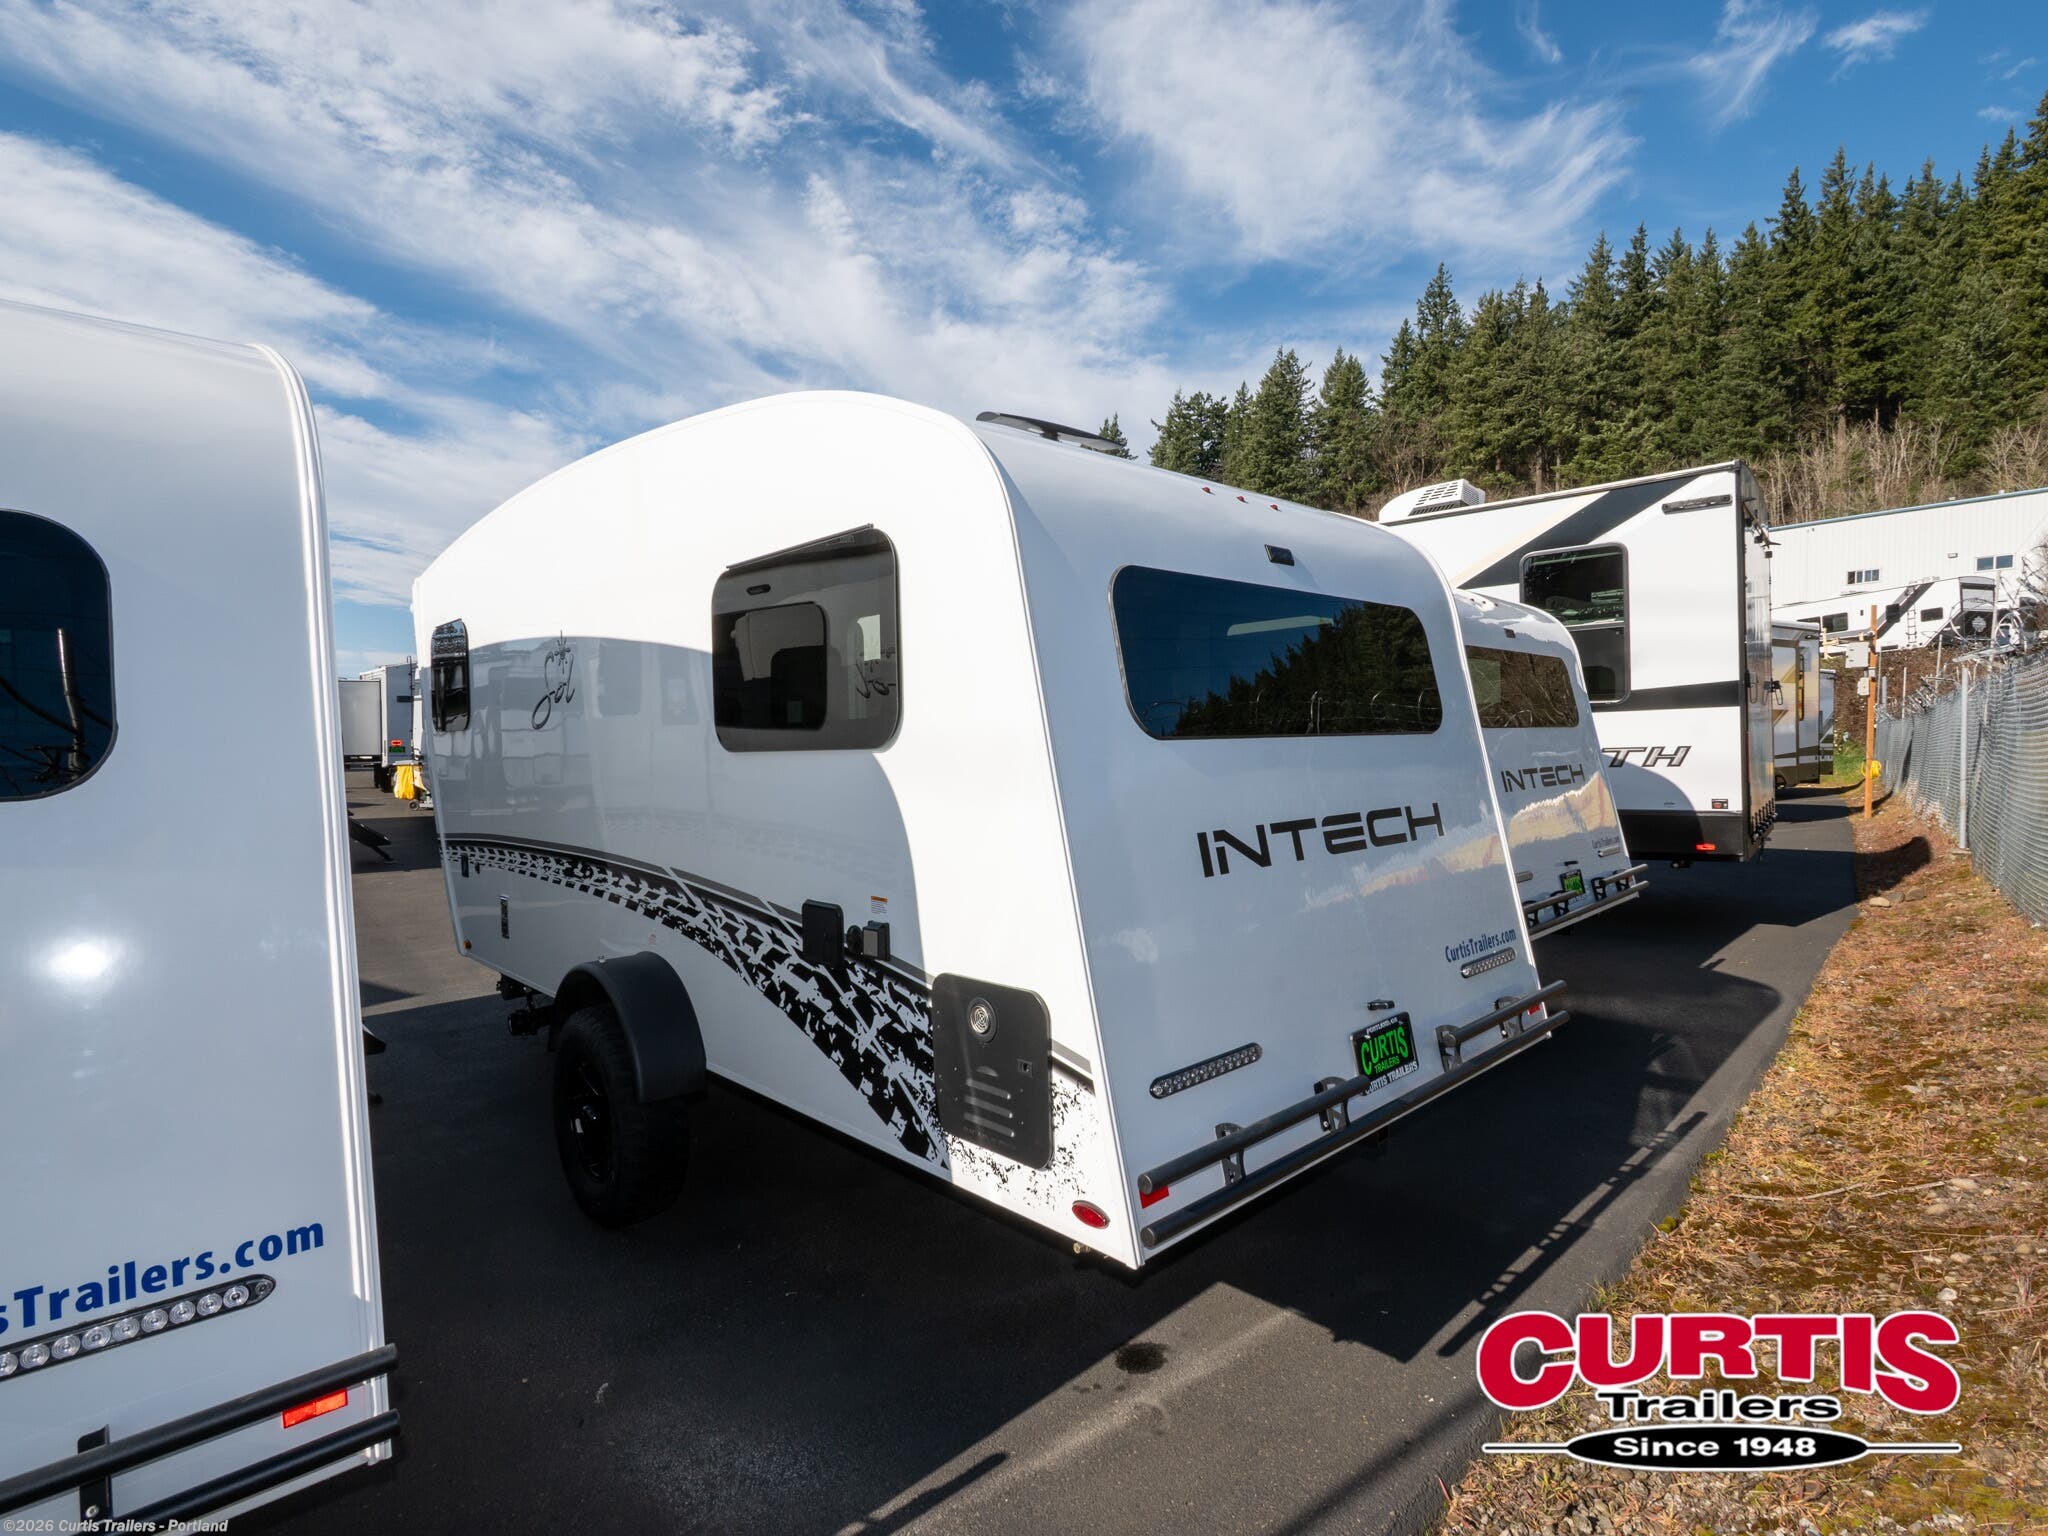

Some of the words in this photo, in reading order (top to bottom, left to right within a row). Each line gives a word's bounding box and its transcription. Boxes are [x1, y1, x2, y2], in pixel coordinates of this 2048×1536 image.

[1500, 763, 1586, 793] INTECH
[1196, 802, 1446, 878] INTECH
[1445, 928, 1517, 963] CurtisTrailers.com
[1361, 1026, 1409, 1076] CURTIS
[1374, 1055, 1401, 1074] TRAILERS
[1387, 1060, 1418, 1083] TRAILERS
